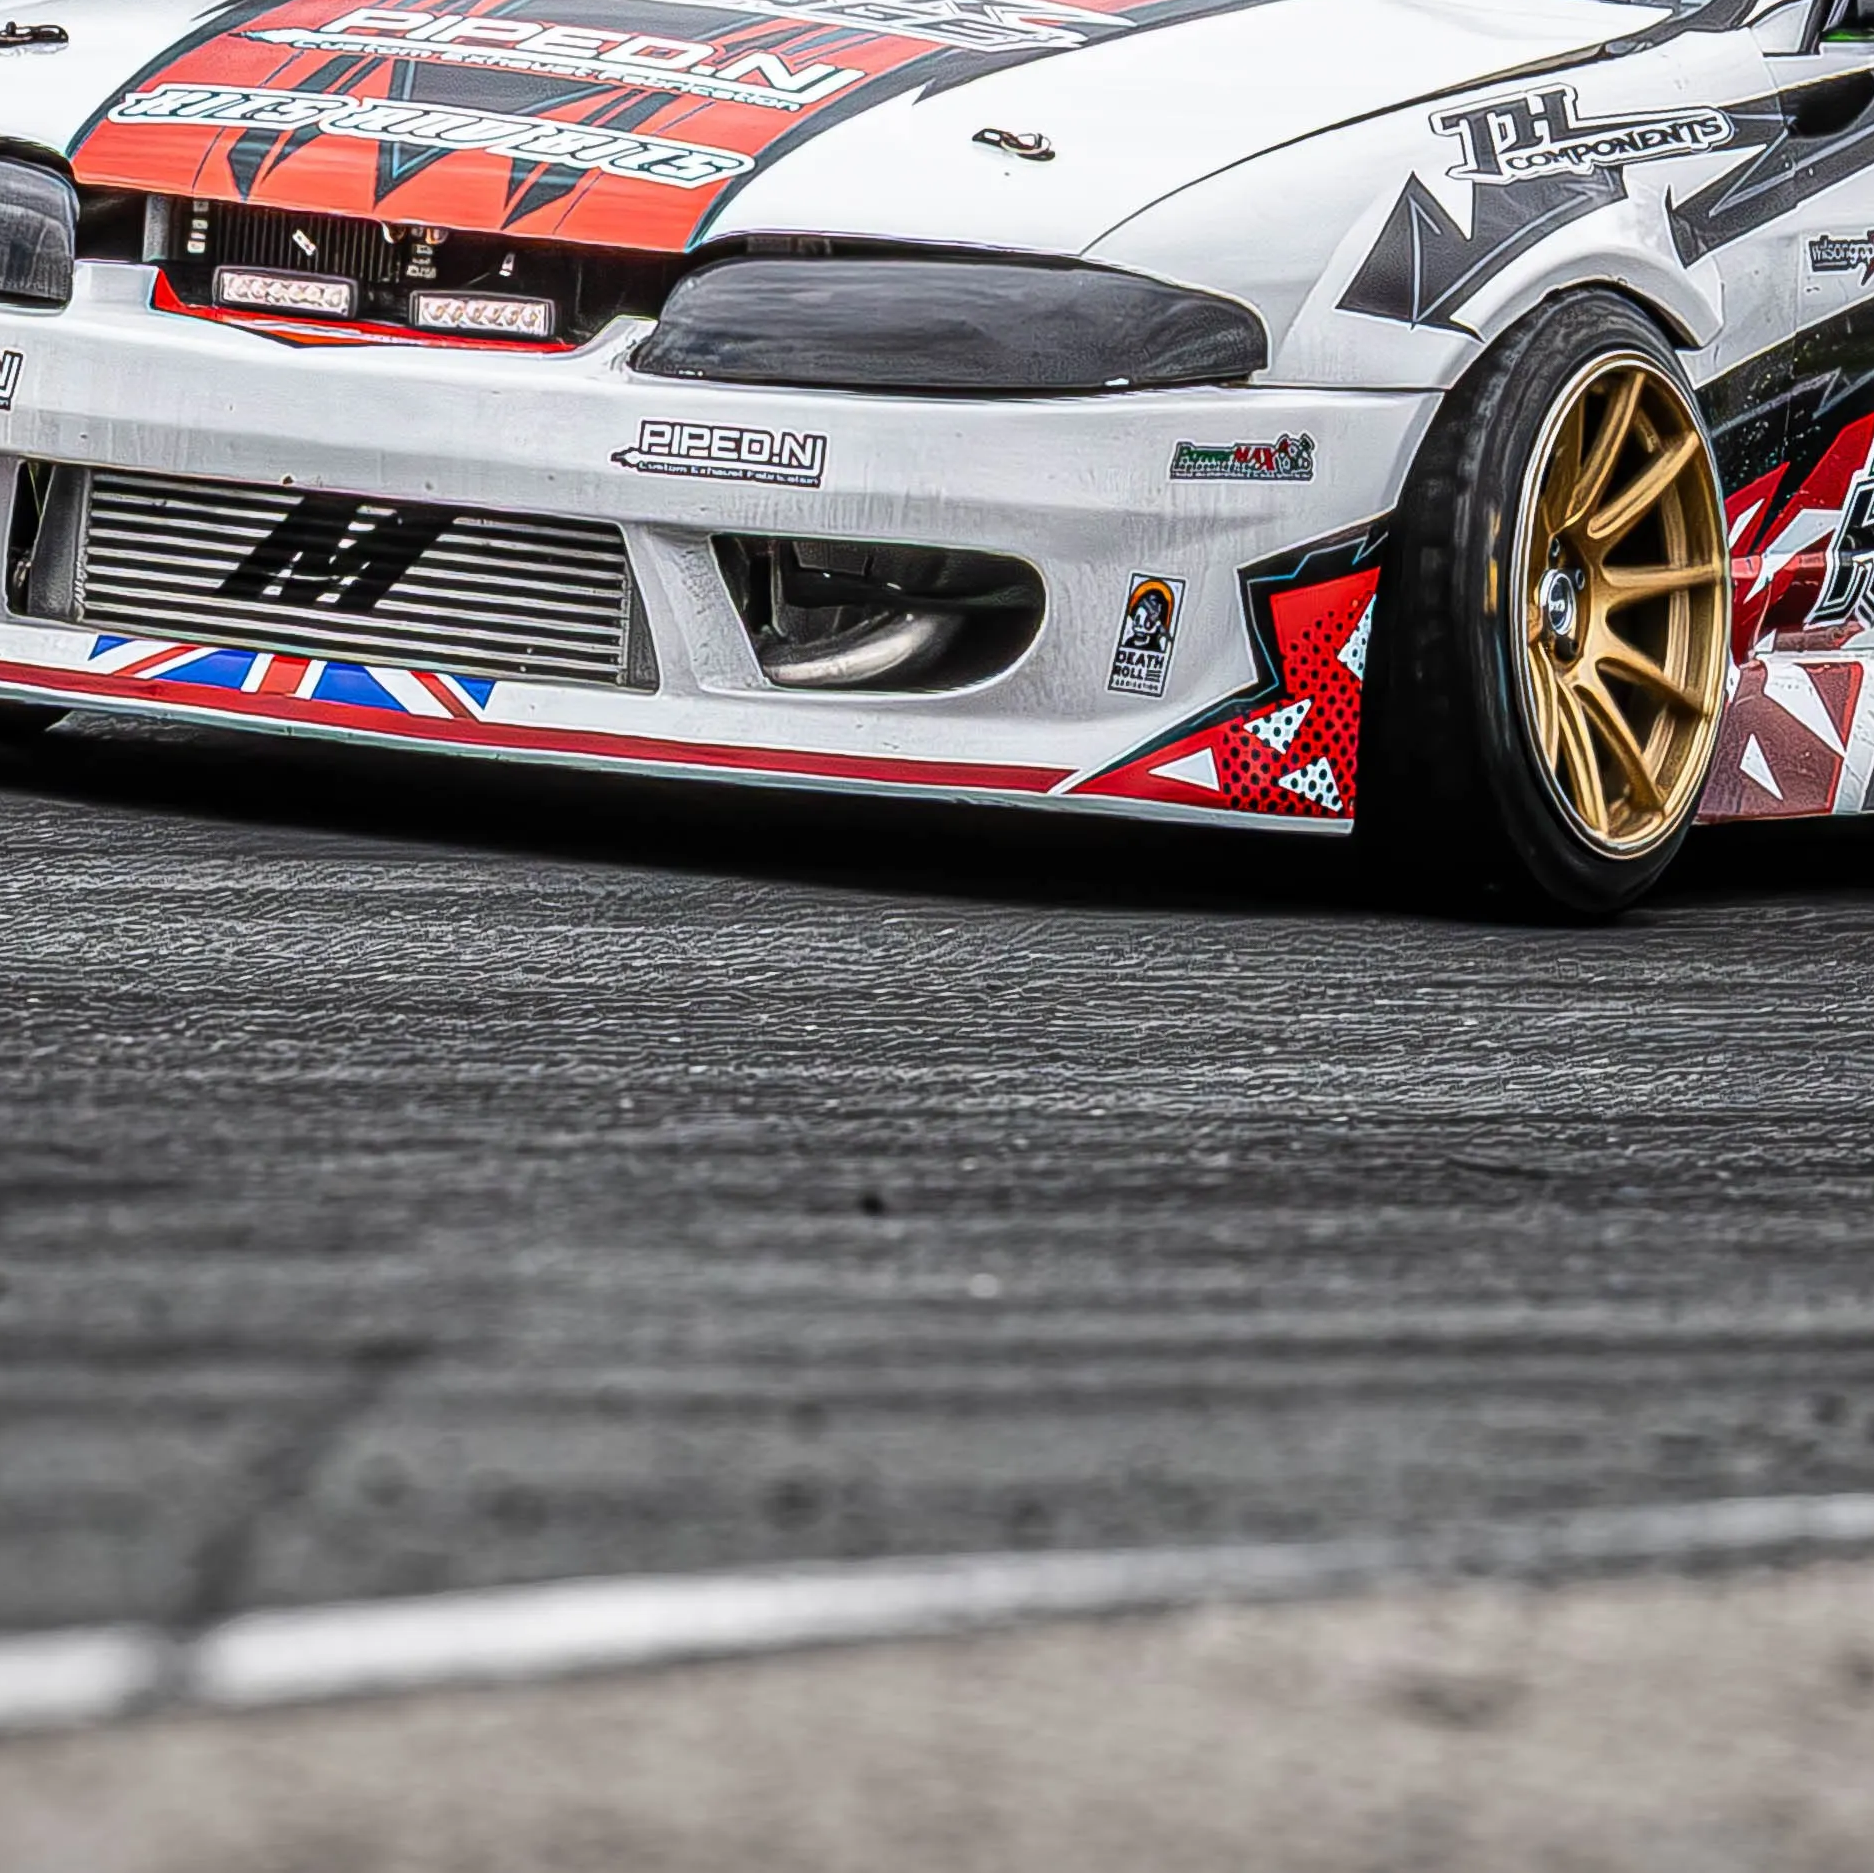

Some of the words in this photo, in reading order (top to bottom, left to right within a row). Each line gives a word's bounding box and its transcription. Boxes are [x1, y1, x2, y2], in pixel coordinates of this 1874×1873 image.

[510, 127, 745, 181] BITS
[1506, 116, 1724, 171] COMPONENTS
[1112, 664, 1143, 680] ROLL
[1116, 649, 1165, 669] DEATH
